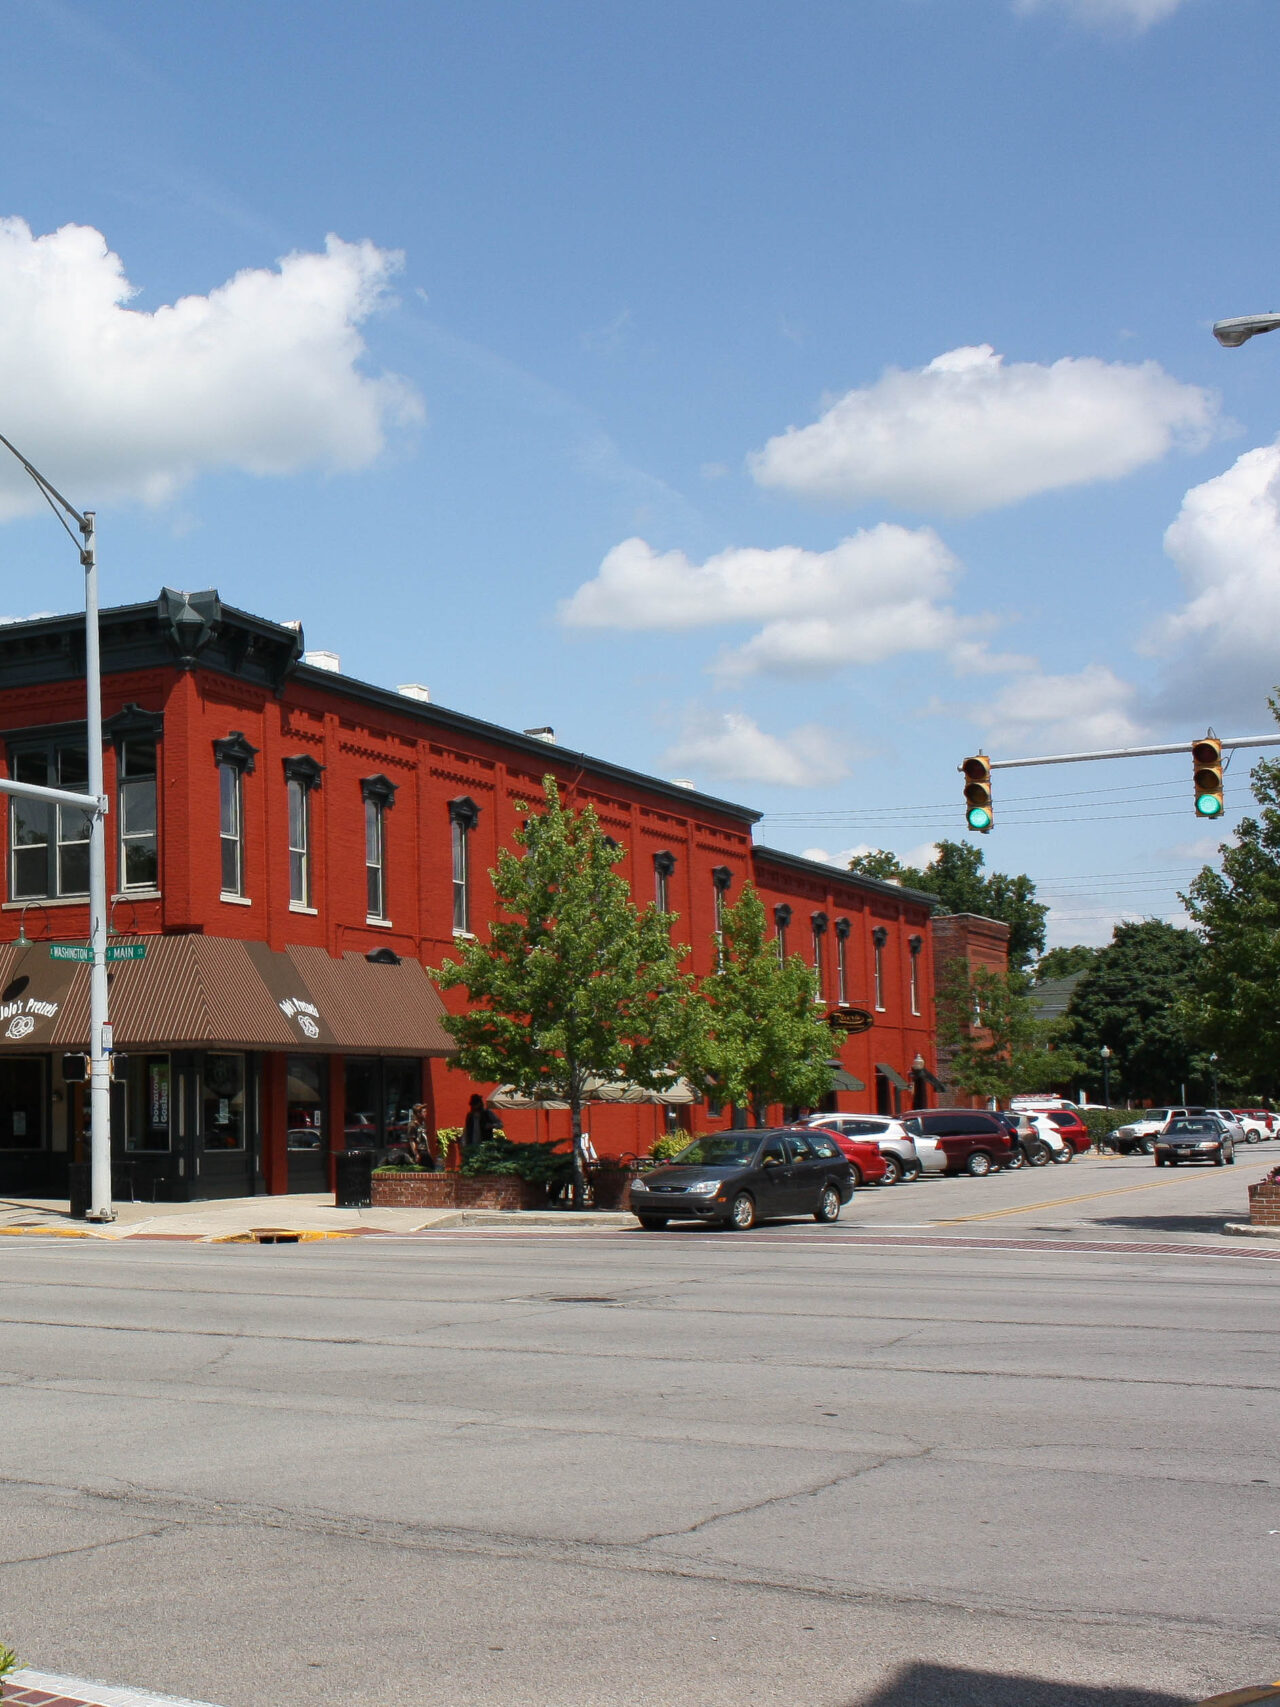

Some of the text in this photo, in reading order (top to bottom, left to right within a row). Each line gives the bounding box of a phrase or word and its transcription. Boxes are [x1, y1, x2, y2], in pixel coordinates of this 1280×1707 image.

[53, 946, 88, 959] WASHINGTON
[113, 947, 134, 959] MAIN
[25, 998, 58, 1018] Pretzels
[152, 1067, 160, 1122] Downtown
[160, 1082, 168, 1123] Goshen
